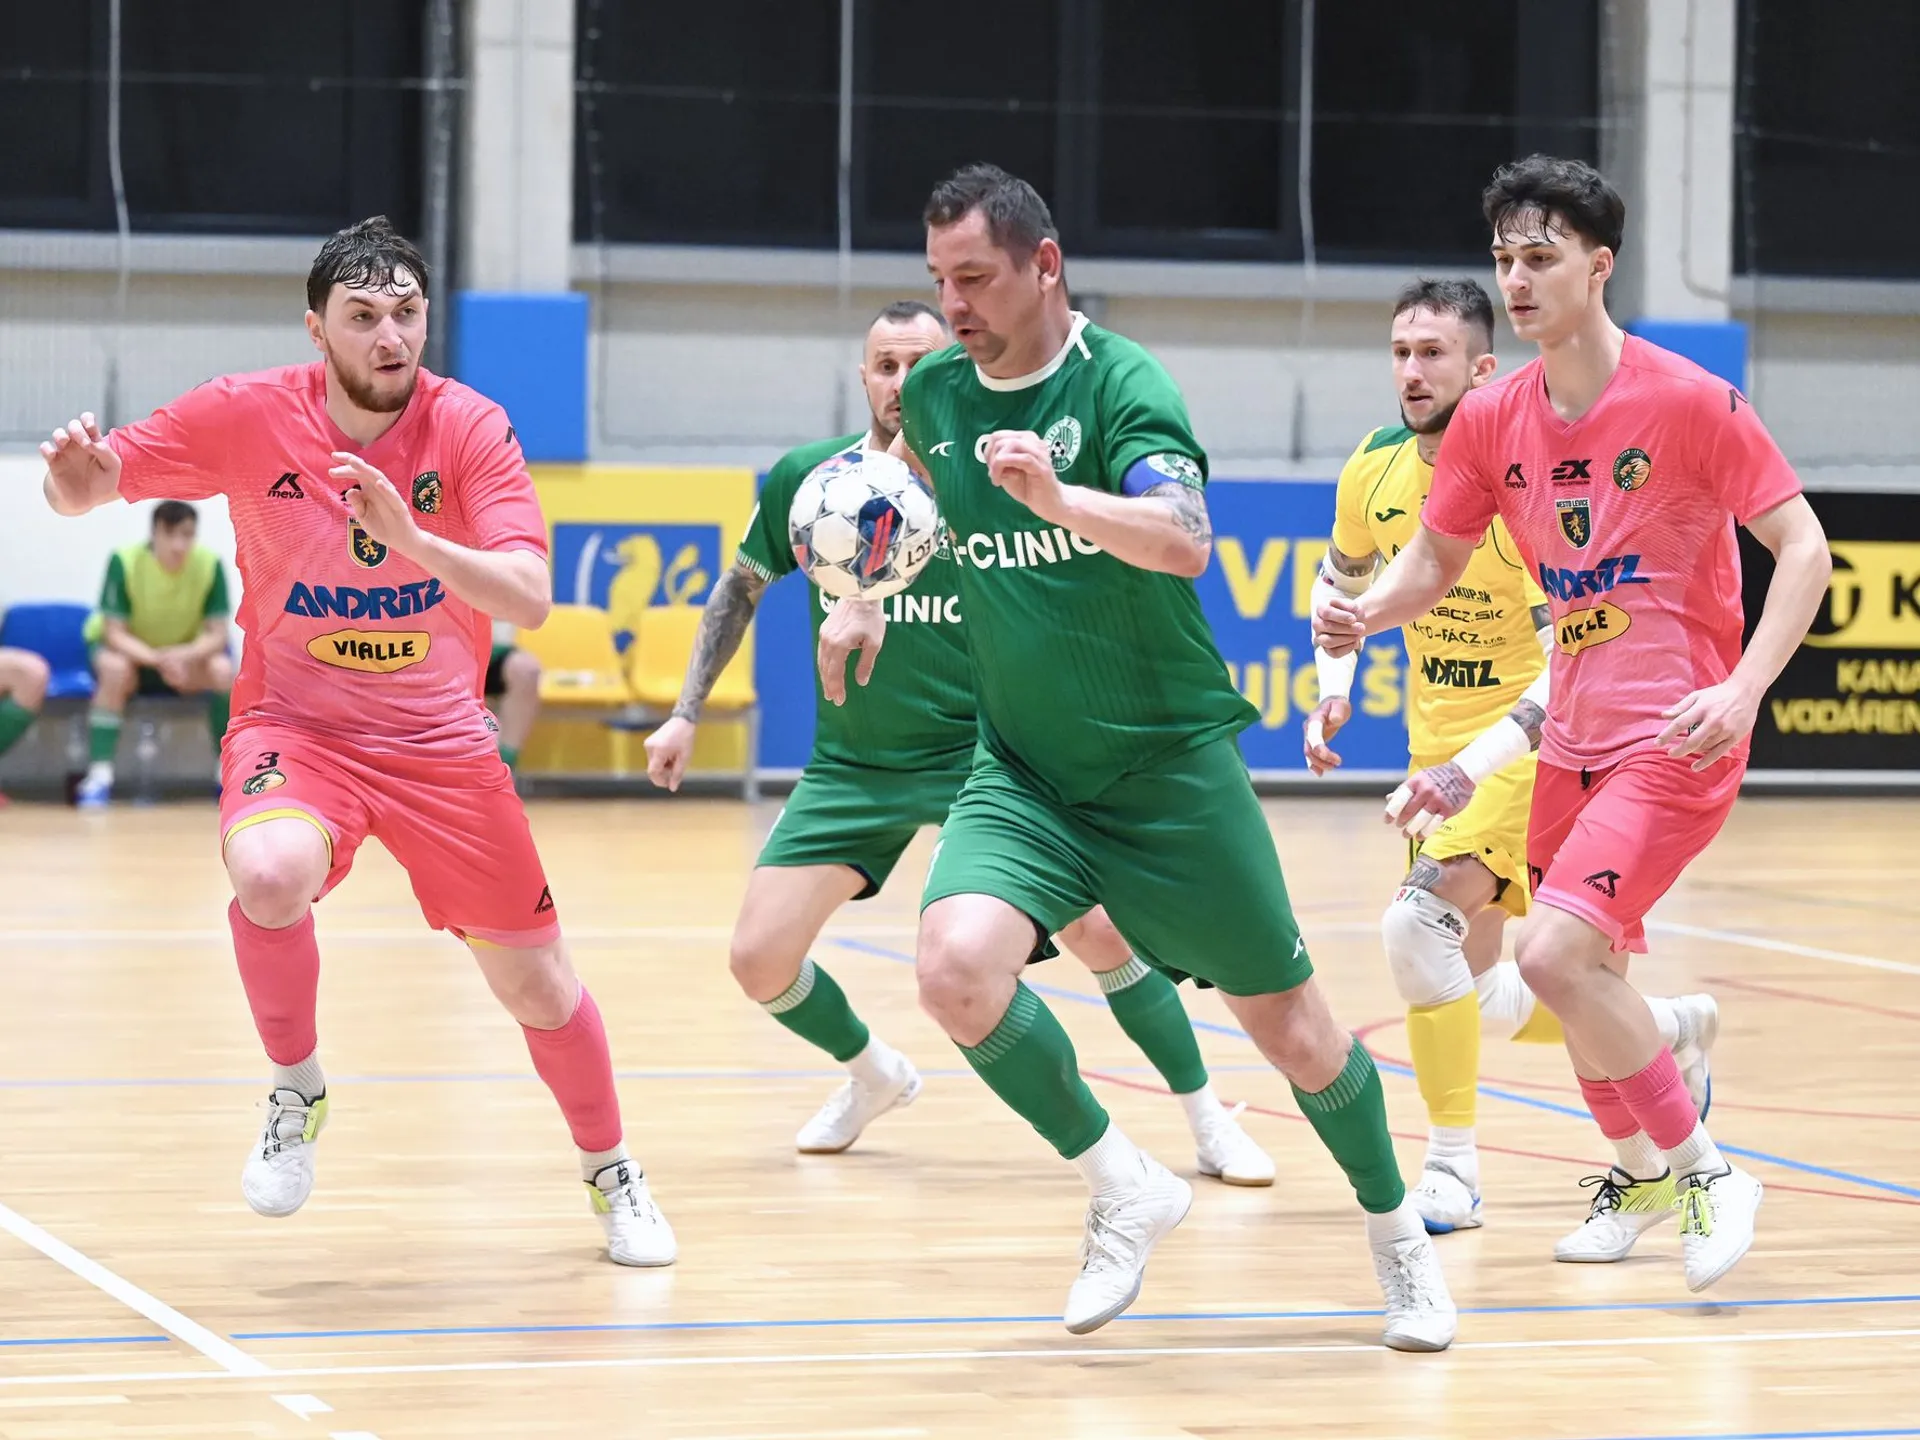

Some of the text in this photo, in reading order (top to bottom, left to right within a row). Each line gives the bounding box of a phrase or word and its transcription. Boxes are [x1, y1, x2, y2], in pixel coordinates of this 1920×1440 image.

[267, 490, 305, 499] meva
[284, 577, 445, 620] ANDRITZ
[333, 640, 415, 660] VIALLE
[255, 752, 280, 770] 3
[1582, 877, 1616, 899] meva
